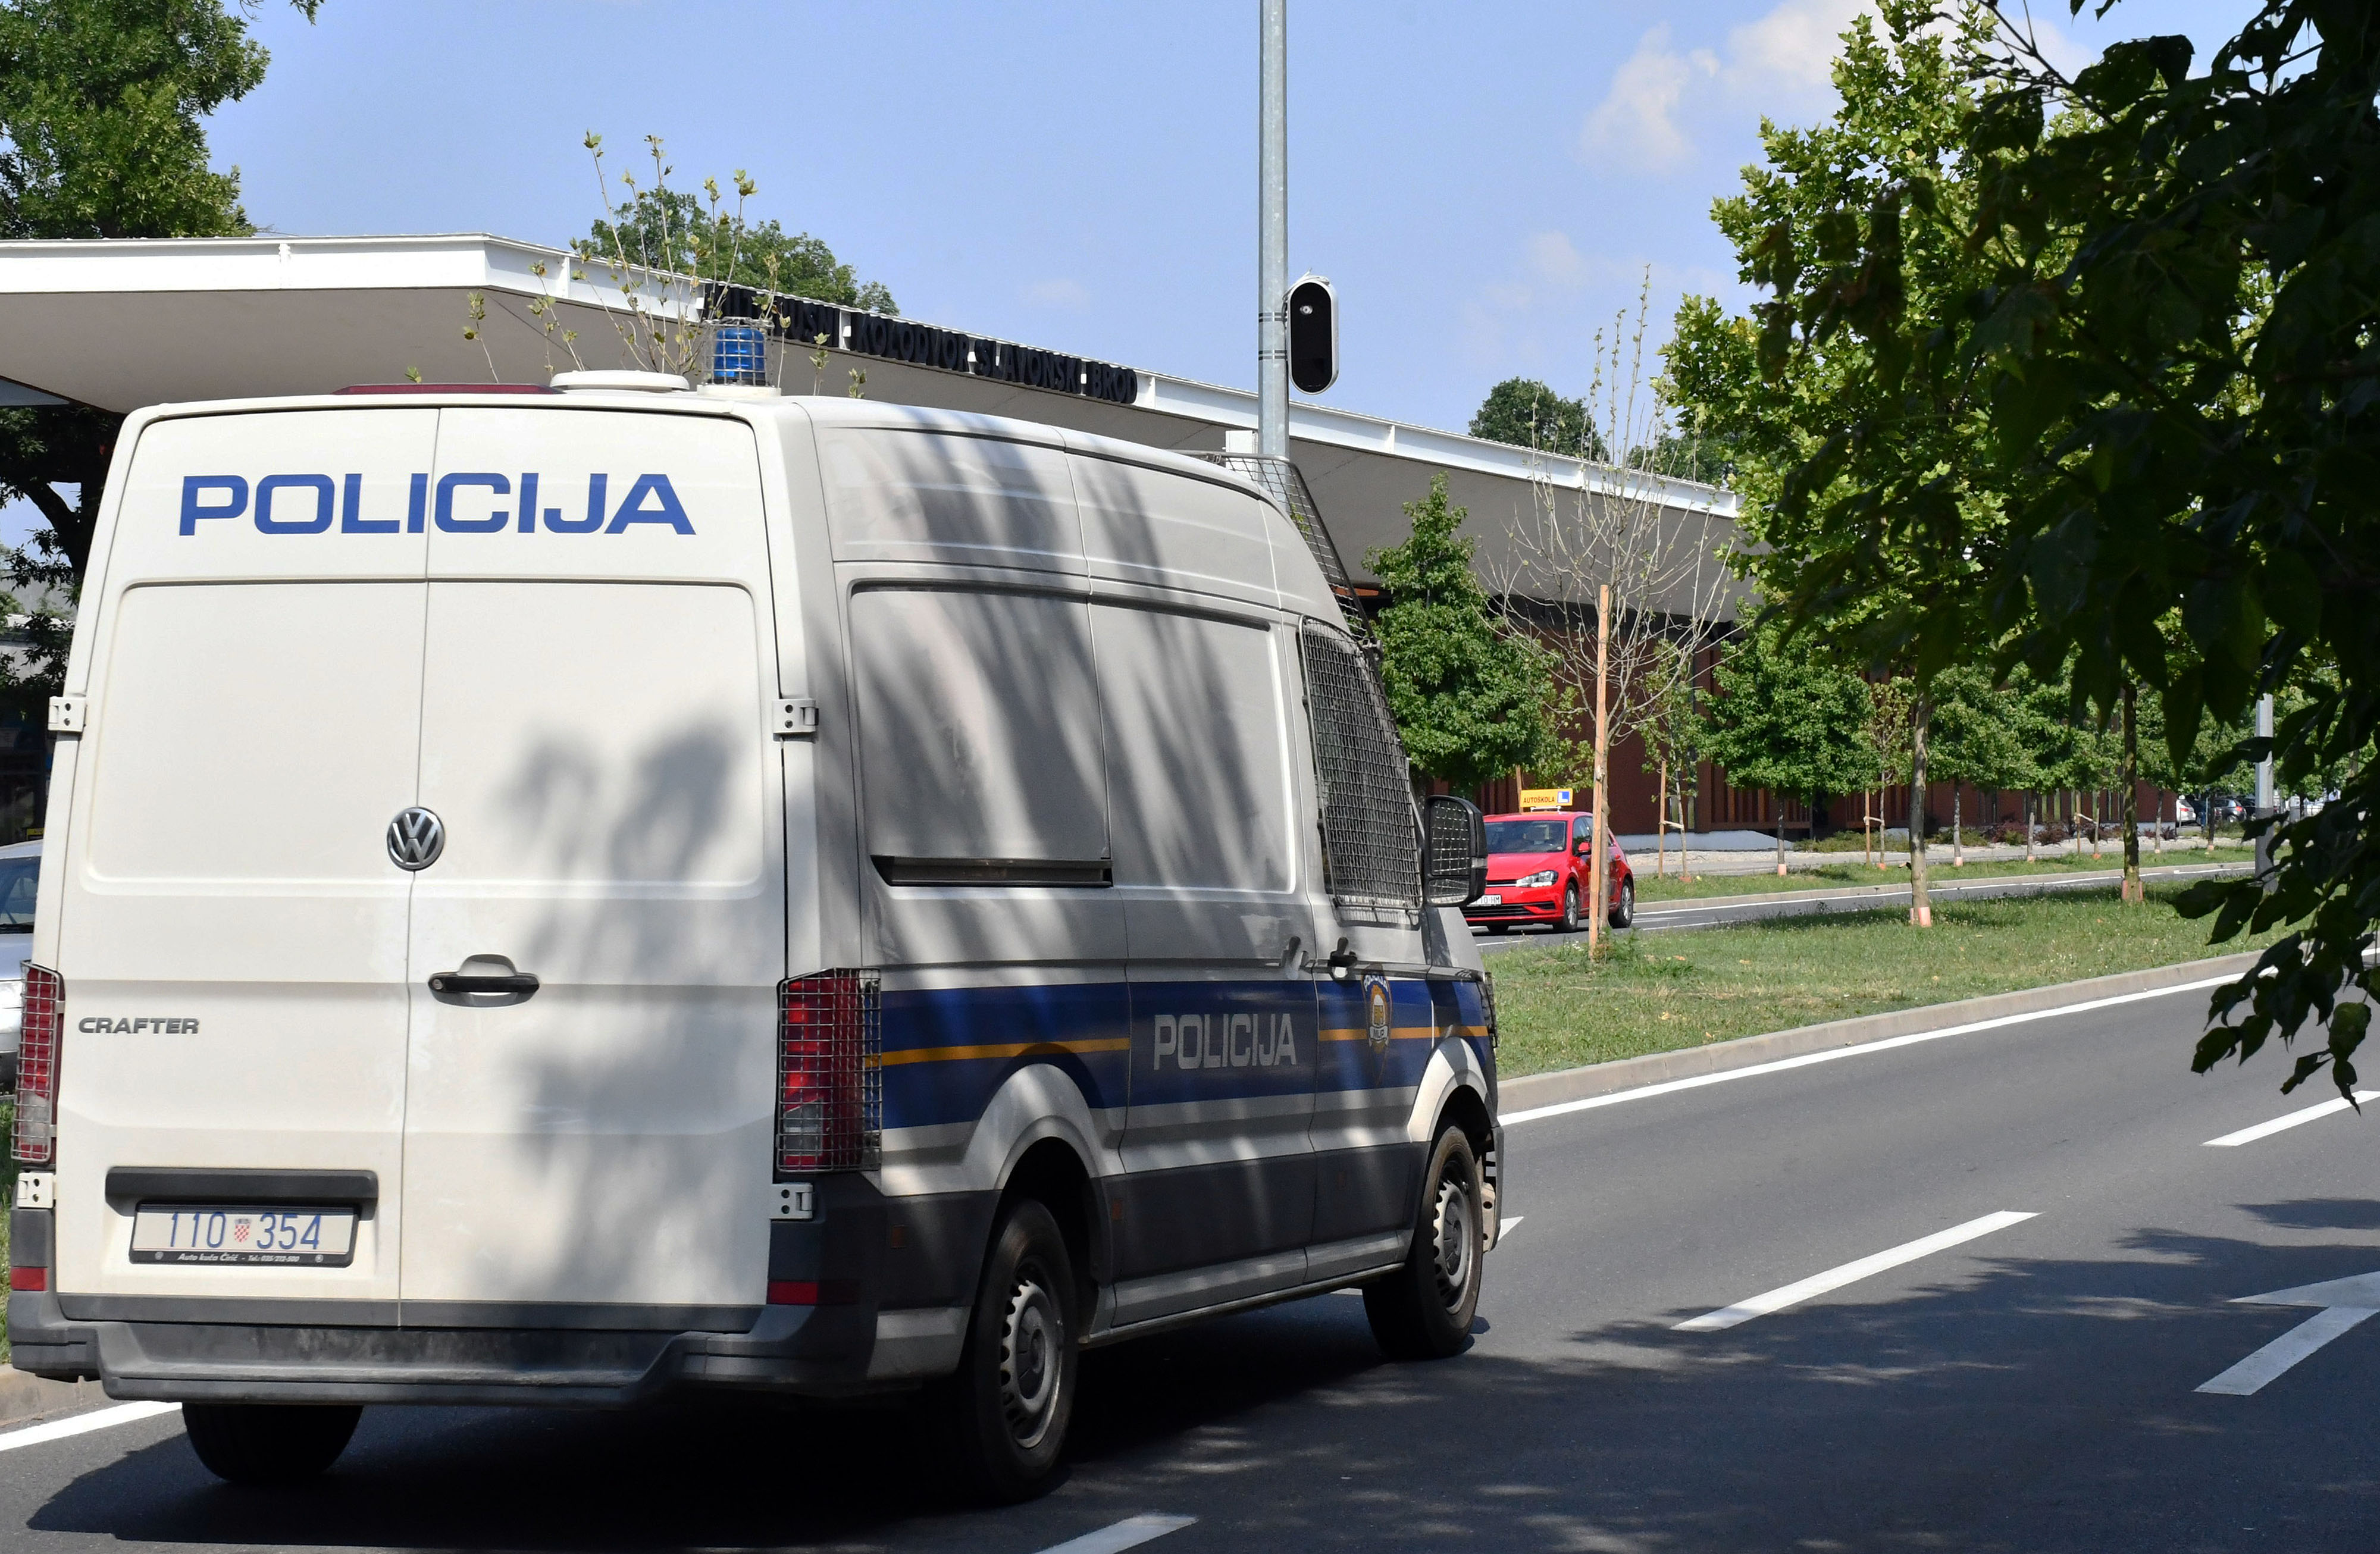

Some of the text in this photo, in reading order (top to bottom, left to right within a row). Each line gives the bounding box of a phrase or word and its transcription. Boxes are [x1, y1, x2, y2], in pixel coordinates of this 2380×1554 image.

[851, 312, 970, 372] KOLODVOR
[975, 339, 1081, 394] SLAVONSKI
[1086, 361, 1138, 404] BROD
[179, 472, 696, 536] POLICIJA
[1523, 795, 1555, 803] AUTOŠKOLA
[79, 1017, 199, 1034] CRAFTER
[1154, 1013, 1297, 1070] POLICIJA
[170, 1211, 322, 1249] 110 354
